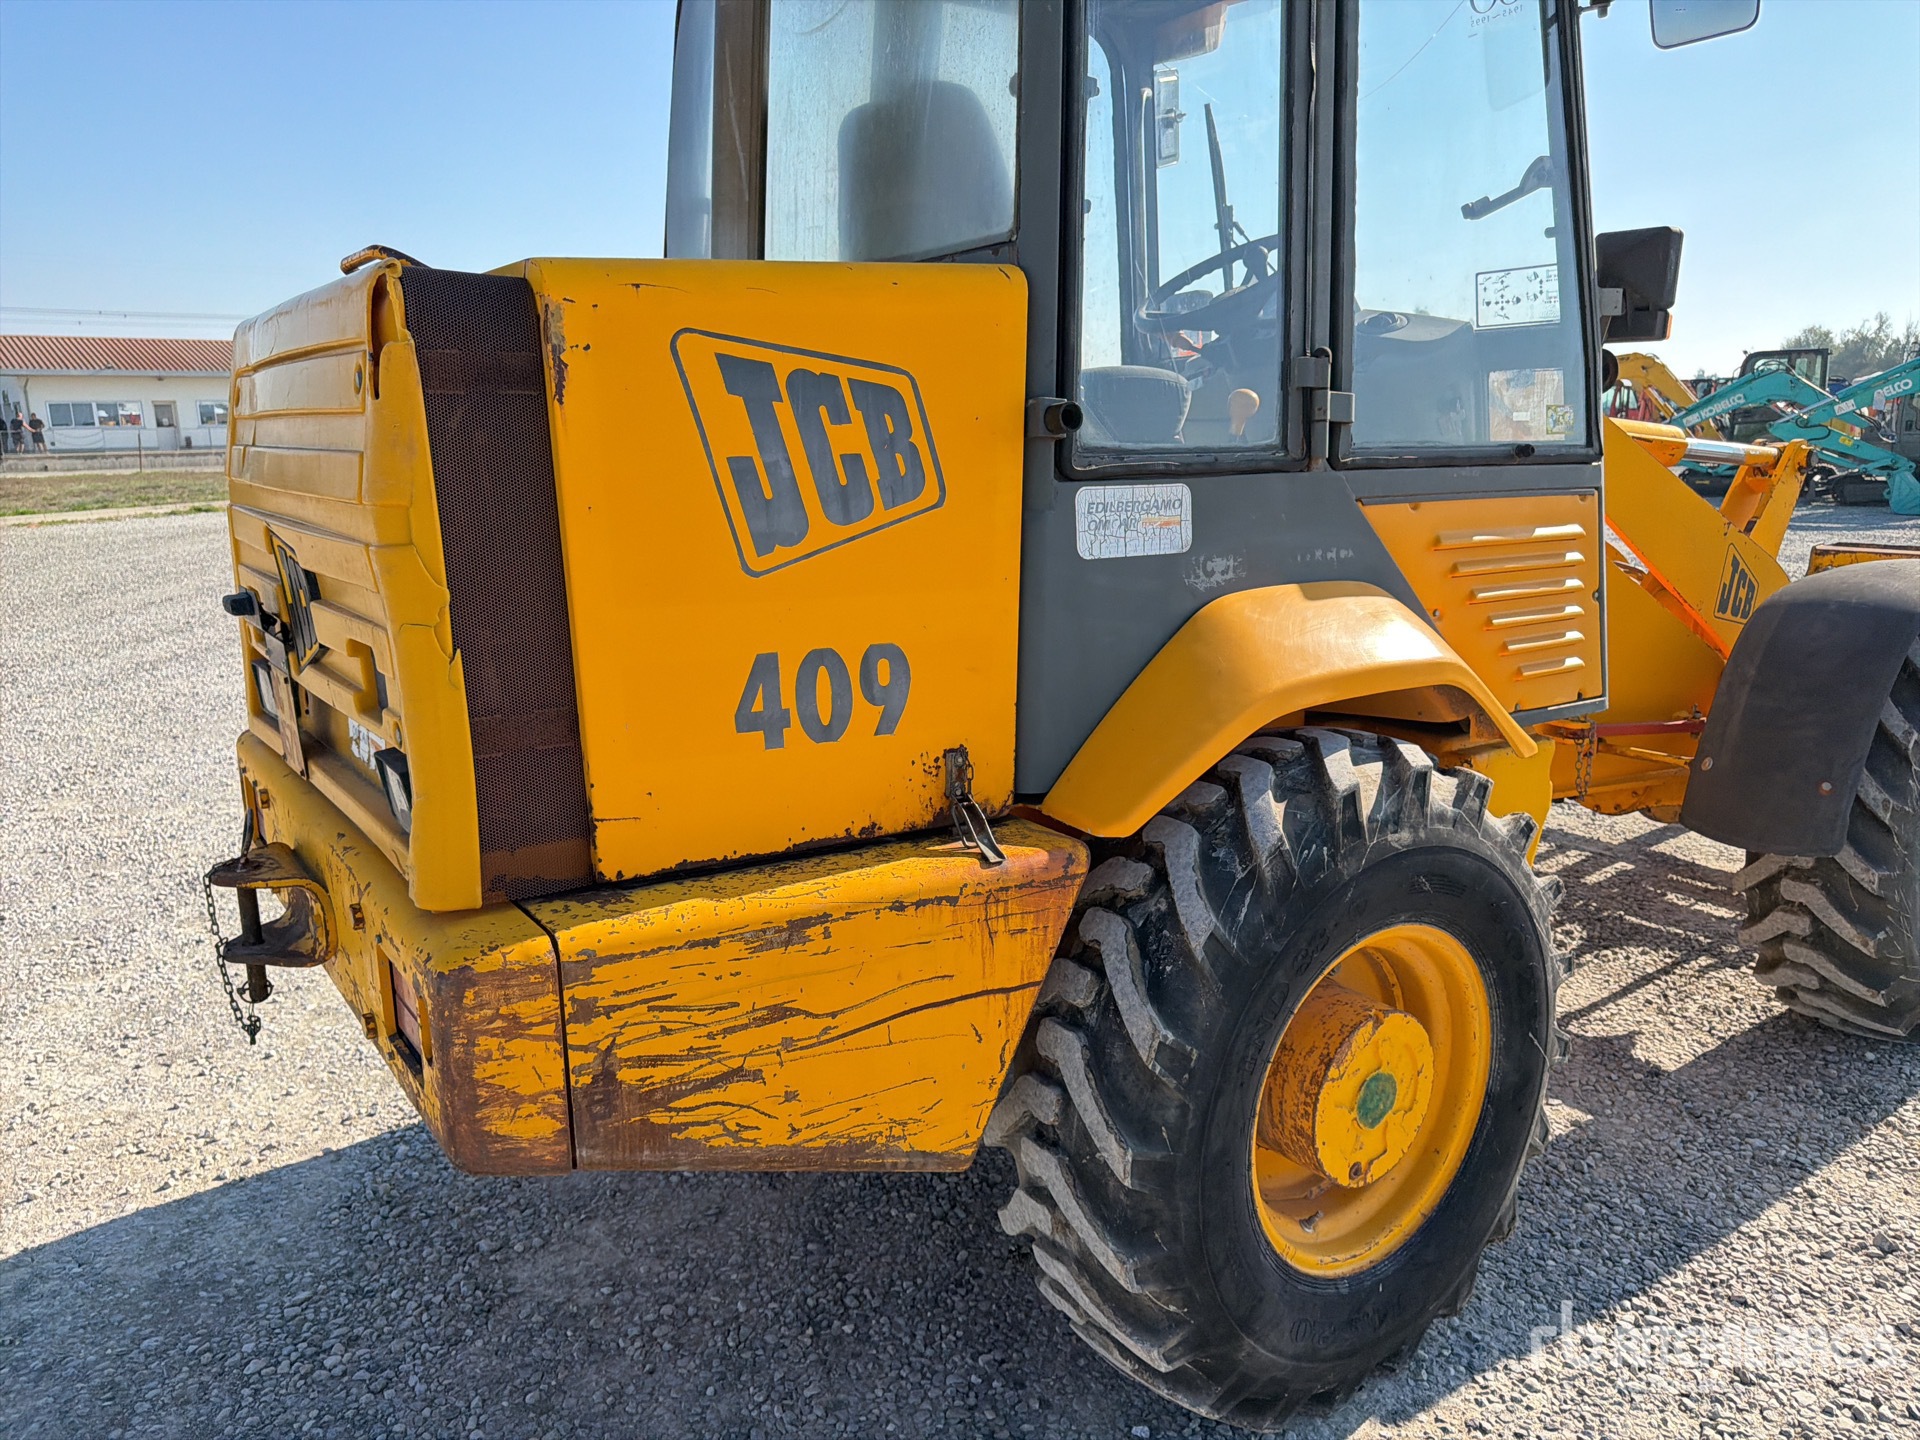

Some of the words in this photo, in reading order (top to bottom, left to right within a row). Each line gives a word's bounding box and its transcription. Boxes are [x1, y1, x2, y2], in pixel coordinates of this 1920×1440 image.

[714, 353, 927, 558] JCB
[1717, 554, 1756, 620] JCB
[734, 643, 911, 750] 409
